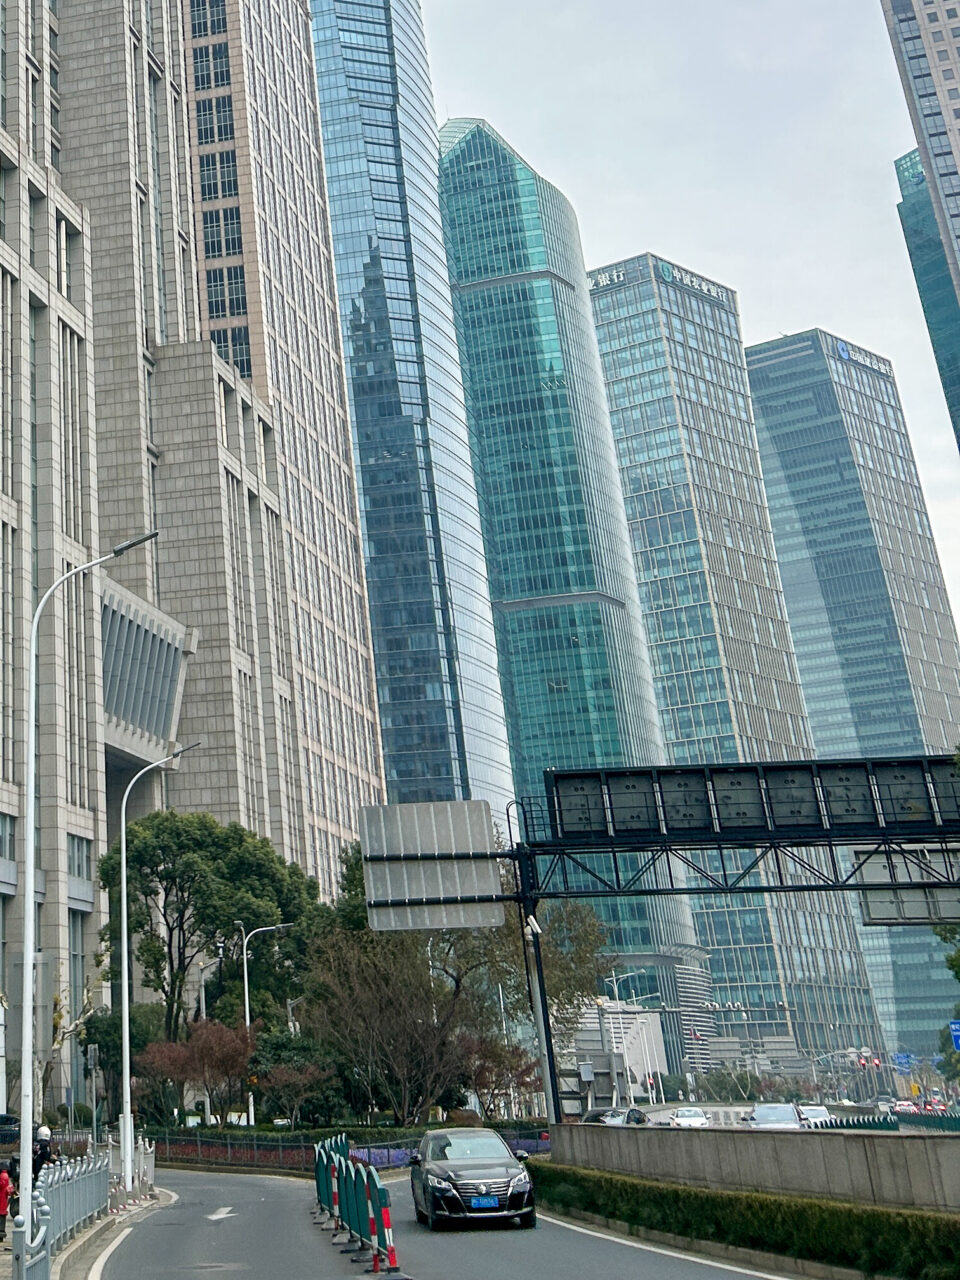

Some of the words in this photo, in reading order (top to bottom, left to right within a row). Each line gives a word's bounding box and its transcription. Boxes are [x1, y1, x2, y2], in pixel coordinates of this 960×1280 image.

[672, 269, 726, 301] 中国农业银行
